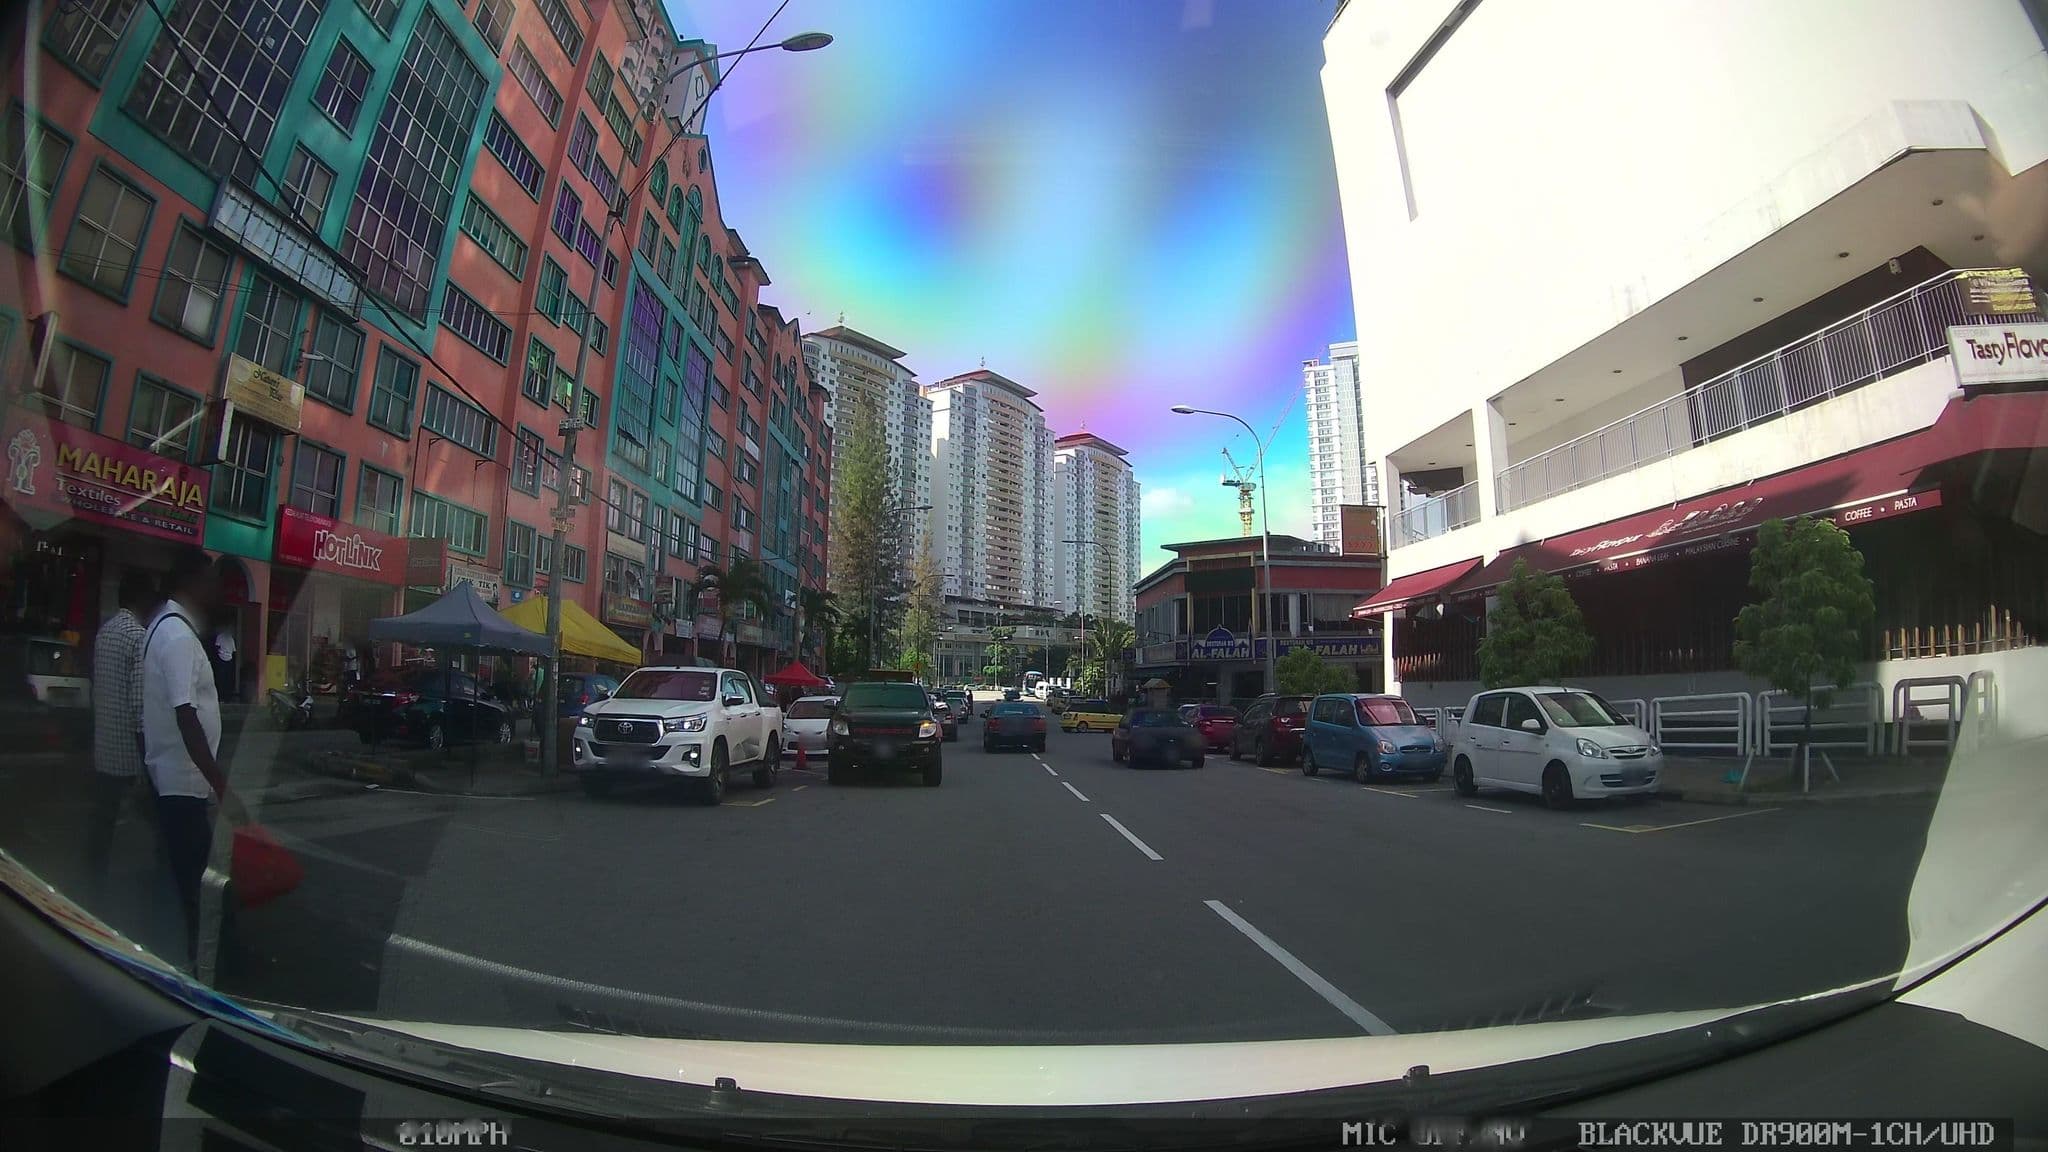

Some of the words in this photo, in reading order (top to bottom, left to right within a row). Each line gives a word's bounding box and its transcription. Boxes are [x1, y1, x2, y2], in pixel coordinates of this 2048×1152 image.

[57, 441, 203, 507] MAHARAJA
[55, 477, 121, 506] Textiles
[1844, 506, 1873, 522] COFFEE
[1894, 496, 1918, 511] PASTA
[154, 519, 193, 535] RETAIL
